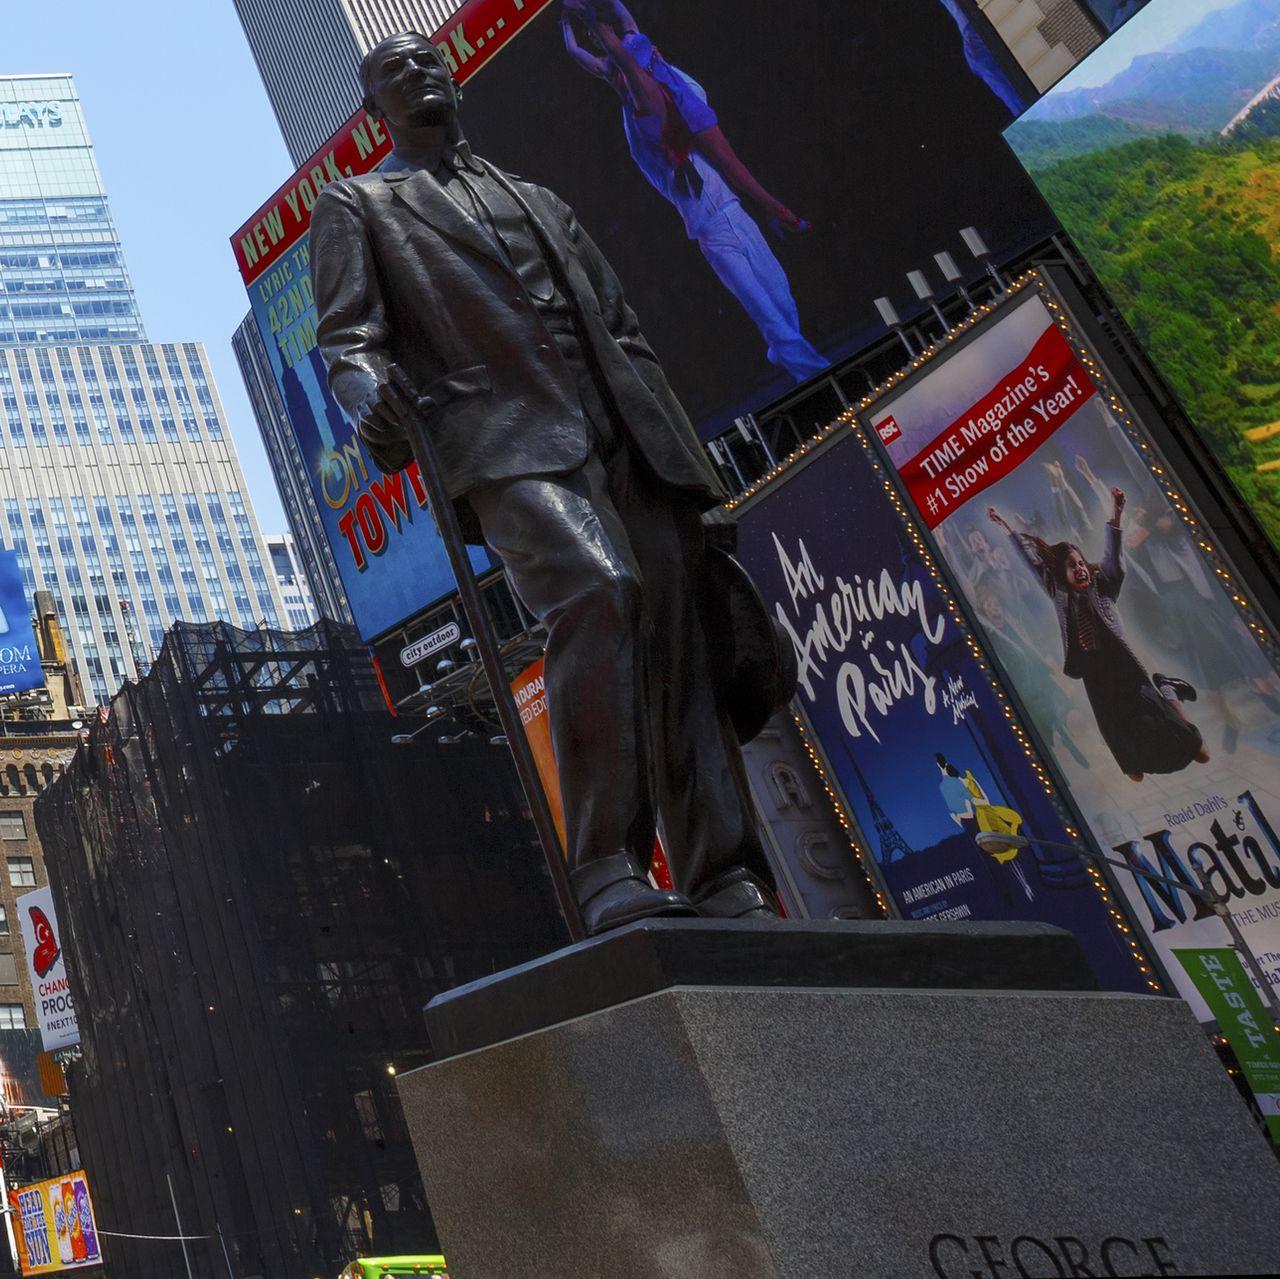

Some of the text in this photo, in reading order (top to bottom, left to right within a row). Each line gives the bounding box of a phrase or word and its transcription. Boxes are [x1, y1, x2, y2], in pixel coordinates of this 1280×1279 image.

[241, 206, 286, 269] NEW
[352, 113, 386, 161] NE
[258, 263, 293, 303] LYRIC
[267, 273, 314, 335] 42ND
[878, 423, 899, 440] RSC
[920, 365, 1050, 479] TIME Magazine's
[926, 374, 1083, 516] #1 Show of the Year!
[322, 435, 369, 510] ON
[772, 532, 824, 617] An
[406, 628, 455, 661] city outdoor
[776, 568, 945, 702] American
[861, 630, 874, 650] in
[837, 641, 936, 744] Paris
[948, 675, 965, 702] New
[953, 691, 979, 725] Musical
[1164, 795, 1228, 828] Roald Dahl's
[902, 868, 975, 904] AN AMERICAN IN PARIS
[1199, 954, 1266, 1049] TASTE
